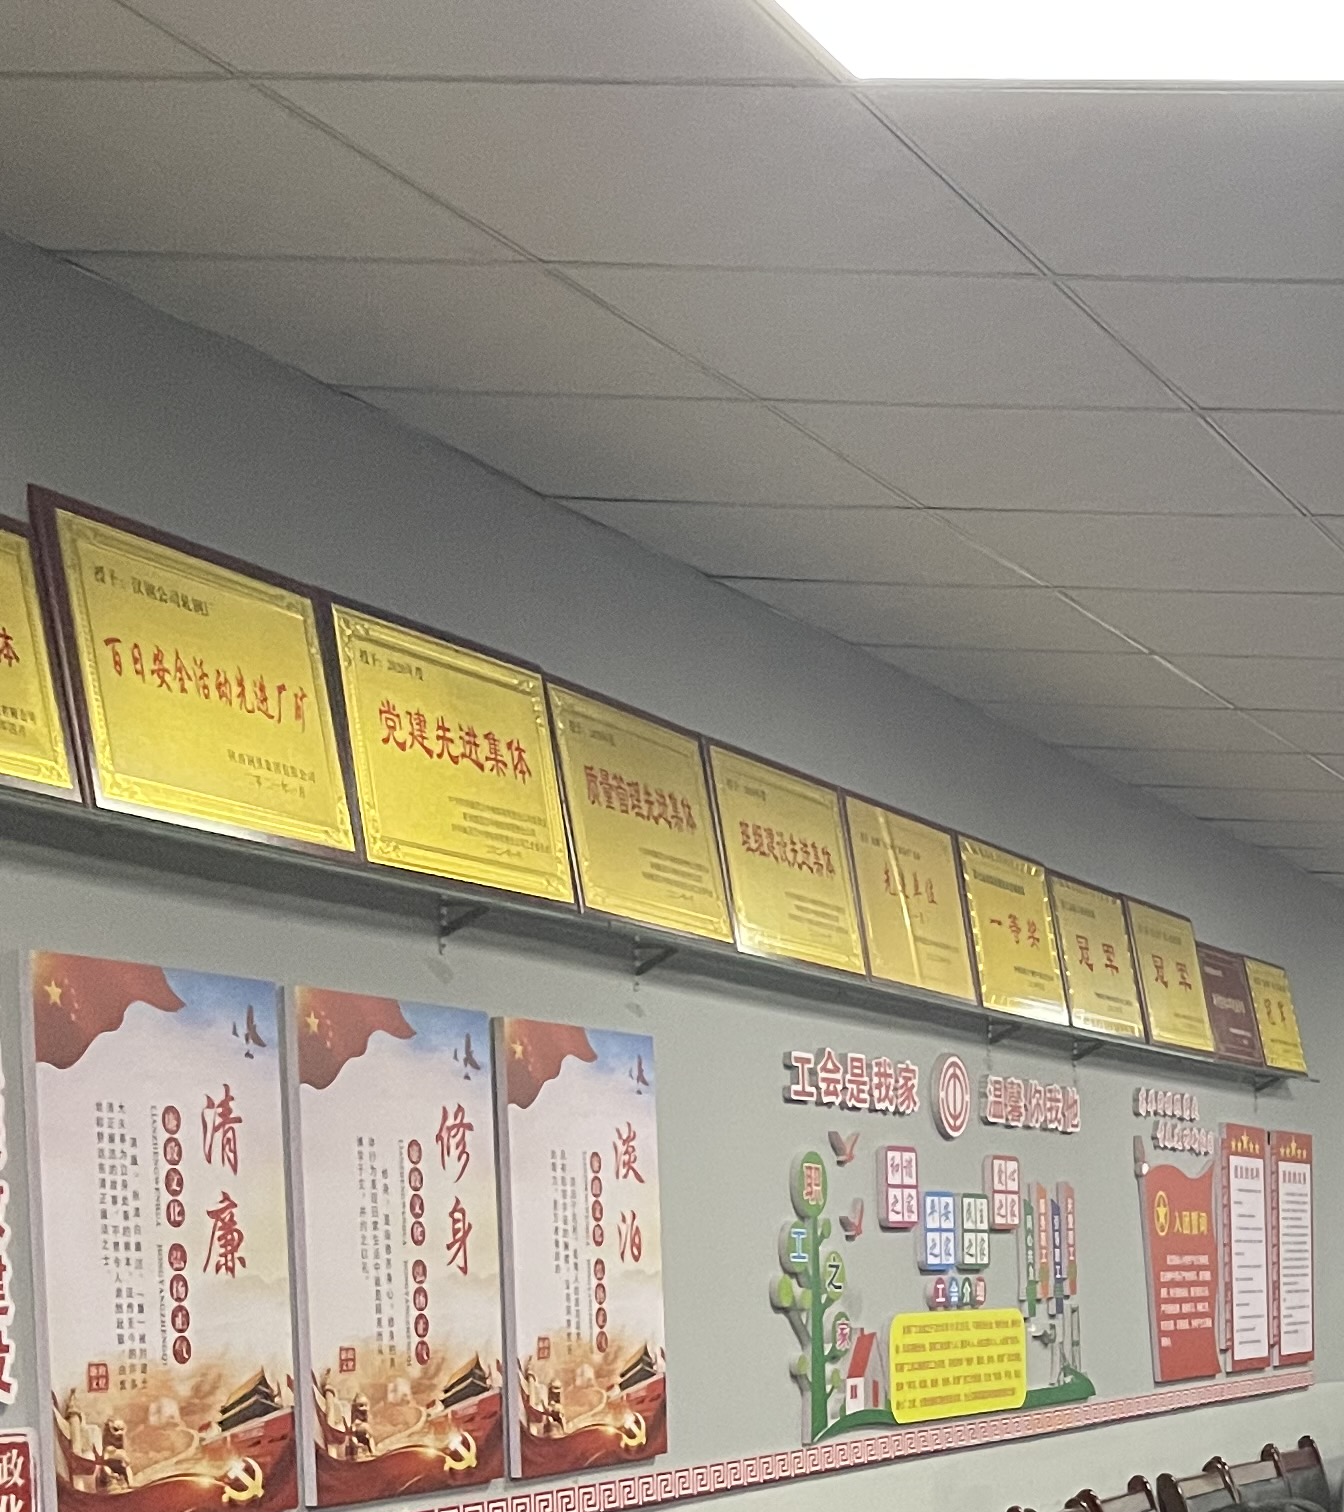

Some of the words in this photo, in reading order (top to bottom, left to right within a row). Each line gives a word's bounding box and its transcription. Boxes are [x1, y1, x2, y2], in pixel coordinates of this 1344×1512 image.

[103, 637, 308, 733] 百日安全活动先进厂矿
[378, 698, 532, 785] 党建先进集体
[583, 765, 697, 835] 质量管理先进集体
[791, 1047, 921, 1115] 工会是我家
[986, 1075, 1081, 1134] 温馨你我他
[201, 1083, 247, 1280] 清廉
[436, 1103, 474, 1277] 修身
[612, 1120, 645, 1264] 淡泊
